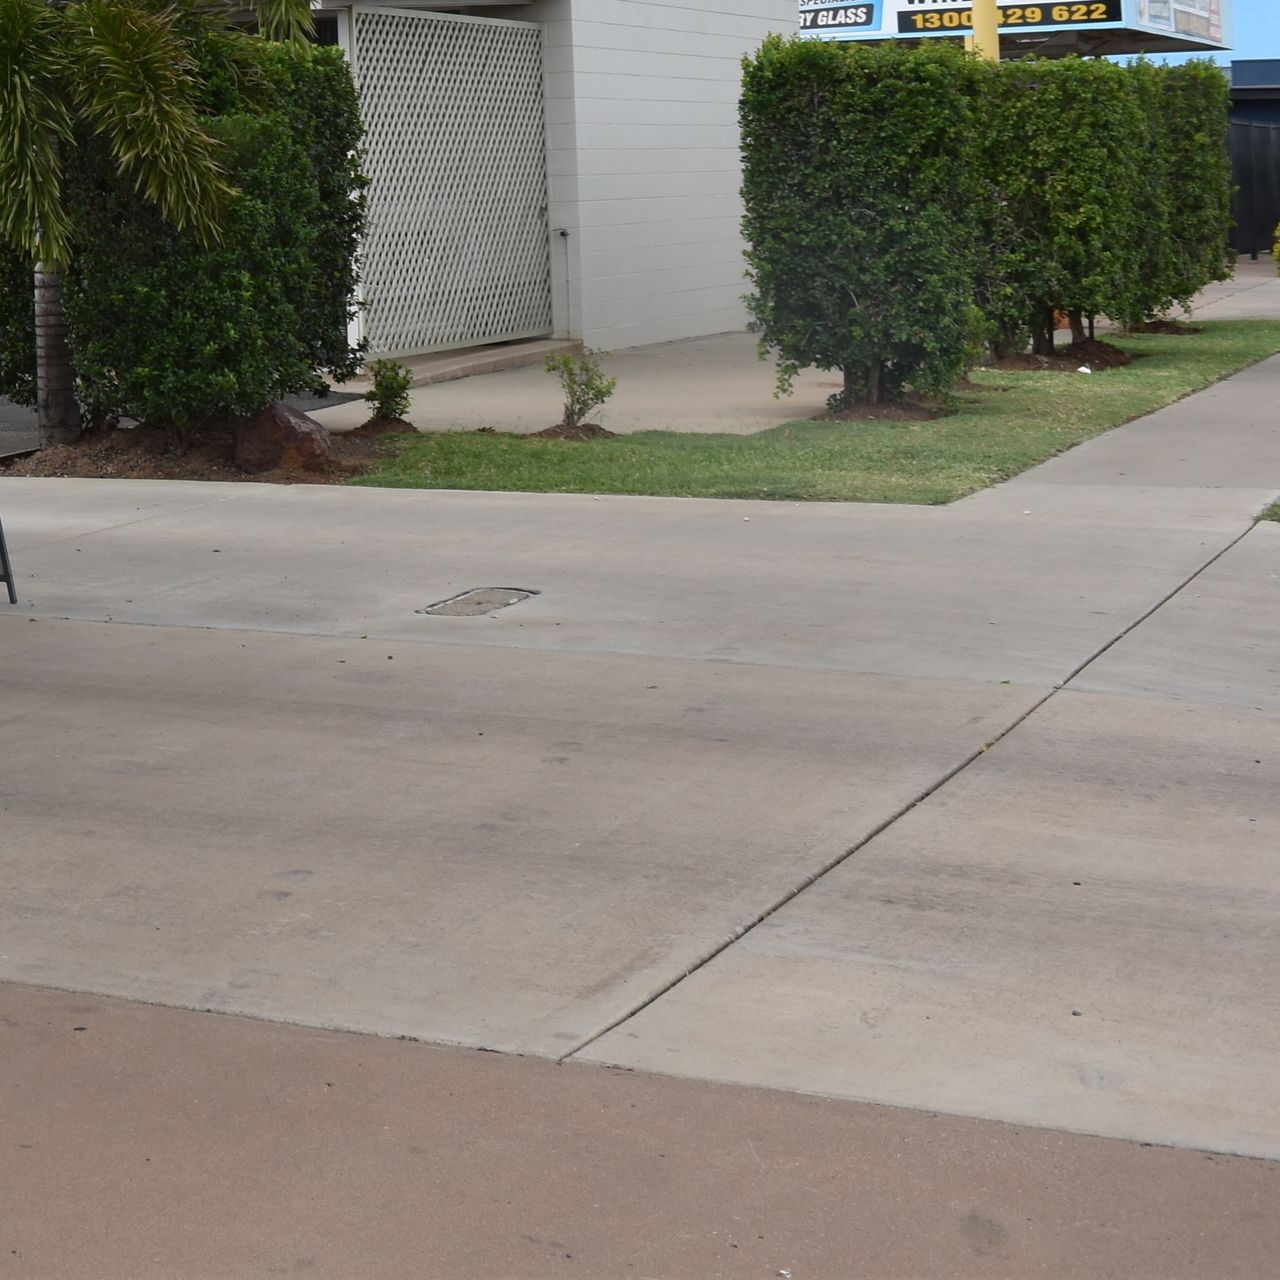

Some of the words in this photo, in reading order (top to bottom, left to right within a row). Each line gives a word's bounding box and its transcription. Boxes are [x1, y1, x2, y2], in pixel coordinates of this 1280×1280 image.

[817, 7, 867, 26] GLASS
[912, 10, 974, 29] 1300
[1051, 3, 1108, 22] 622
